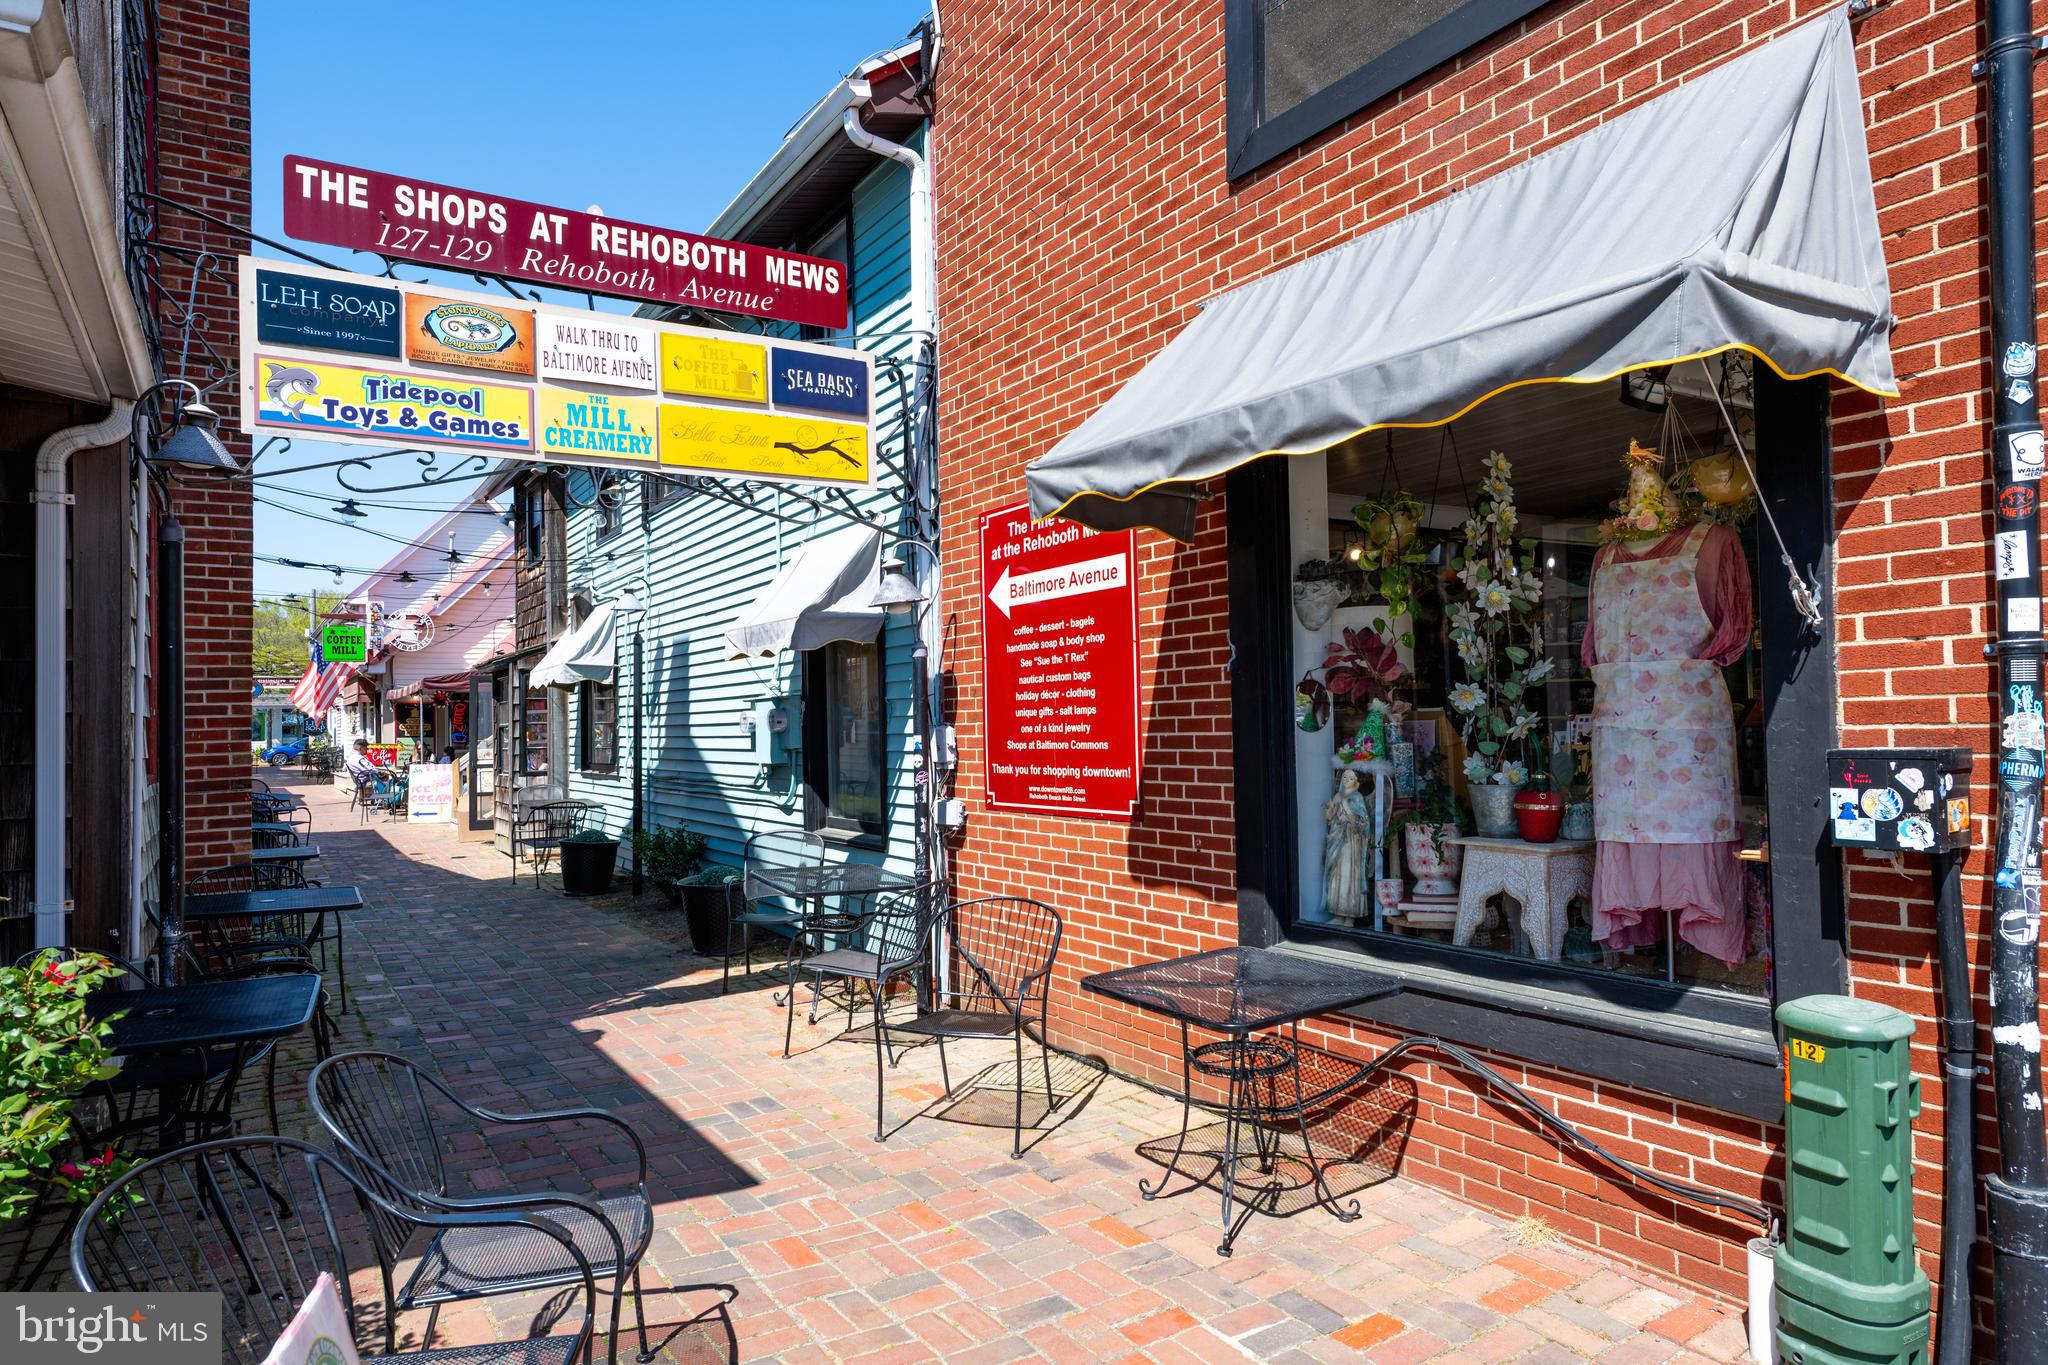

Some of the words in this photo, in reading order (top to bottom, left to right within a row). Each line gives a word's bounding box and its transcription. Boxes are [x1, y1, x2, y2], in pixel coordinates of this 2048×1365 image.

[295, 163, 369, 209] THE
[394, 184, 507, 234] SHOPS
[529, 210, 569, 245] AT
[590, 221, 746, 278] REHOBOTH
[765, 254, 840, 294] MEWS
[375, 222, 493, 263] 127-129
[519, 247, 655, 292] Rehoboth
[679, 277, 774, 312] Avenue
[289, 306, 378, 328] company
[329, 293, 396, 327] SOAP
[436, 305, 507, 328] STONEWORKS
[303, 326, 332, 338] Since
[335, 330, 360, 341] 1997
[555, 325, 589, 347] WALK
[592, 329, 620, 351] THRU
[623, 333, 638, 353] TO
[443, 336, 498, 352] LAPIDARY
[699, 343, 729, 361] THE
[412, 348, 440, 357] UNIQUE
[441, 351, 461, 359] GIFTS
[467, 355, 497, 363] JEWELRY
[502, 360, 529, 368] FOSSILS
[441, 357, 474, 366] CANDLES
[514, 366, 531, 374] SALT
[543, 350, 607, 375] BALTIMORE
[611, 358, 653, 382] AVENUE
[674, 355, 730, 375] COFFEE
[694, 373, 730, 392] MILL
[787, 368, 813, 391] SEA
[817, 372, 853, 398] BAGS
[807, 387, 835, 396] MAINE
[366, 378, 481, 413] Tidepool
[588, 394, 609, 405] THE
[322, 398, 389, 428] Toys
[399, 407, 419, 428] &
[429, 411, 520, 438] Games
[566, 402, 632, 433] MILL
[545, 425, 653, 455] CREAMERY
[673, 420, 716, 443] Bella
[720, 424, 770, 449] Luna
[750, 454, 785, 469] Body
[2002, 508, 2017, 518] THE
[2019, 507, 2032, 517] PIT
[1007, 521, 1028, 537] The
[991, 547, 1002, 561] at
[1003, 542, 1021, 558] the
[1023, 525, 1079, 553] Rehoboth
[1009, 576, 1066, 599] Baltimore
[1068, 566, 1118, 588] Avenue
[1013, 625, 1034, 636] coffee
[1039, 620, 1065, 633] dessert
[1070, 616, 1095, 629] bagels
[326, 635, 362, 645] COFFEE
[1006, 640, 1040, 653] handmade
[1040, 639, 1058, 649] soap
[1059, 637, 1065, 646] &
[1066, 635, 1084, 646] body
[1086, 633, 1105, 644] shop
[331, 645, 357, 655] MILL
[1020, 658, 1033, 668] See
[1051, 655, 1063, 665] the
[1064, 653, 1069, 663] T
[1018, 673, 1045, 685] nautical
[1045, 672, 1072, 682] custom
[1073, 670, 1092, 682] bags
[1015, 691, 1039, 702] holiday
[1040, 689, 1060, 700] décor
[1065, 687, 1096, 699] clothing
[1015, 708, 1037, 719] unique
[1038, 706, 1054, 718] gifts
[1059, 706, 1073, 716] salt
[1074, 705, 1097, 717] lamps
[1020, 725, 1033, 733] one
[1034, 723, 1041, 733] of
[1042, 725, 1047, 733] a
[1048, 723, 1064, 733] kind
[1064, 722, 1091, 734] jewelry
[1006, 740, 1027, 751] Shops
[1028, 741, 1035, 750] at
[1036, 740, 1069, 750] Baltimore
[1070, 740, 1109, 750] Commons
[372, 748, 392, 762] Coffee
[992, 763, 1014, 774] Thank
[1014, 766, 1028, 777] you
[1030, 764, 1041, 774] for
[1042, 765, 1080, 779] shopping
[1082, 765, 1131, 778] downtown!
[411, 785, 431, 793] ICE
[410, 794, 452, 803] CREAM
